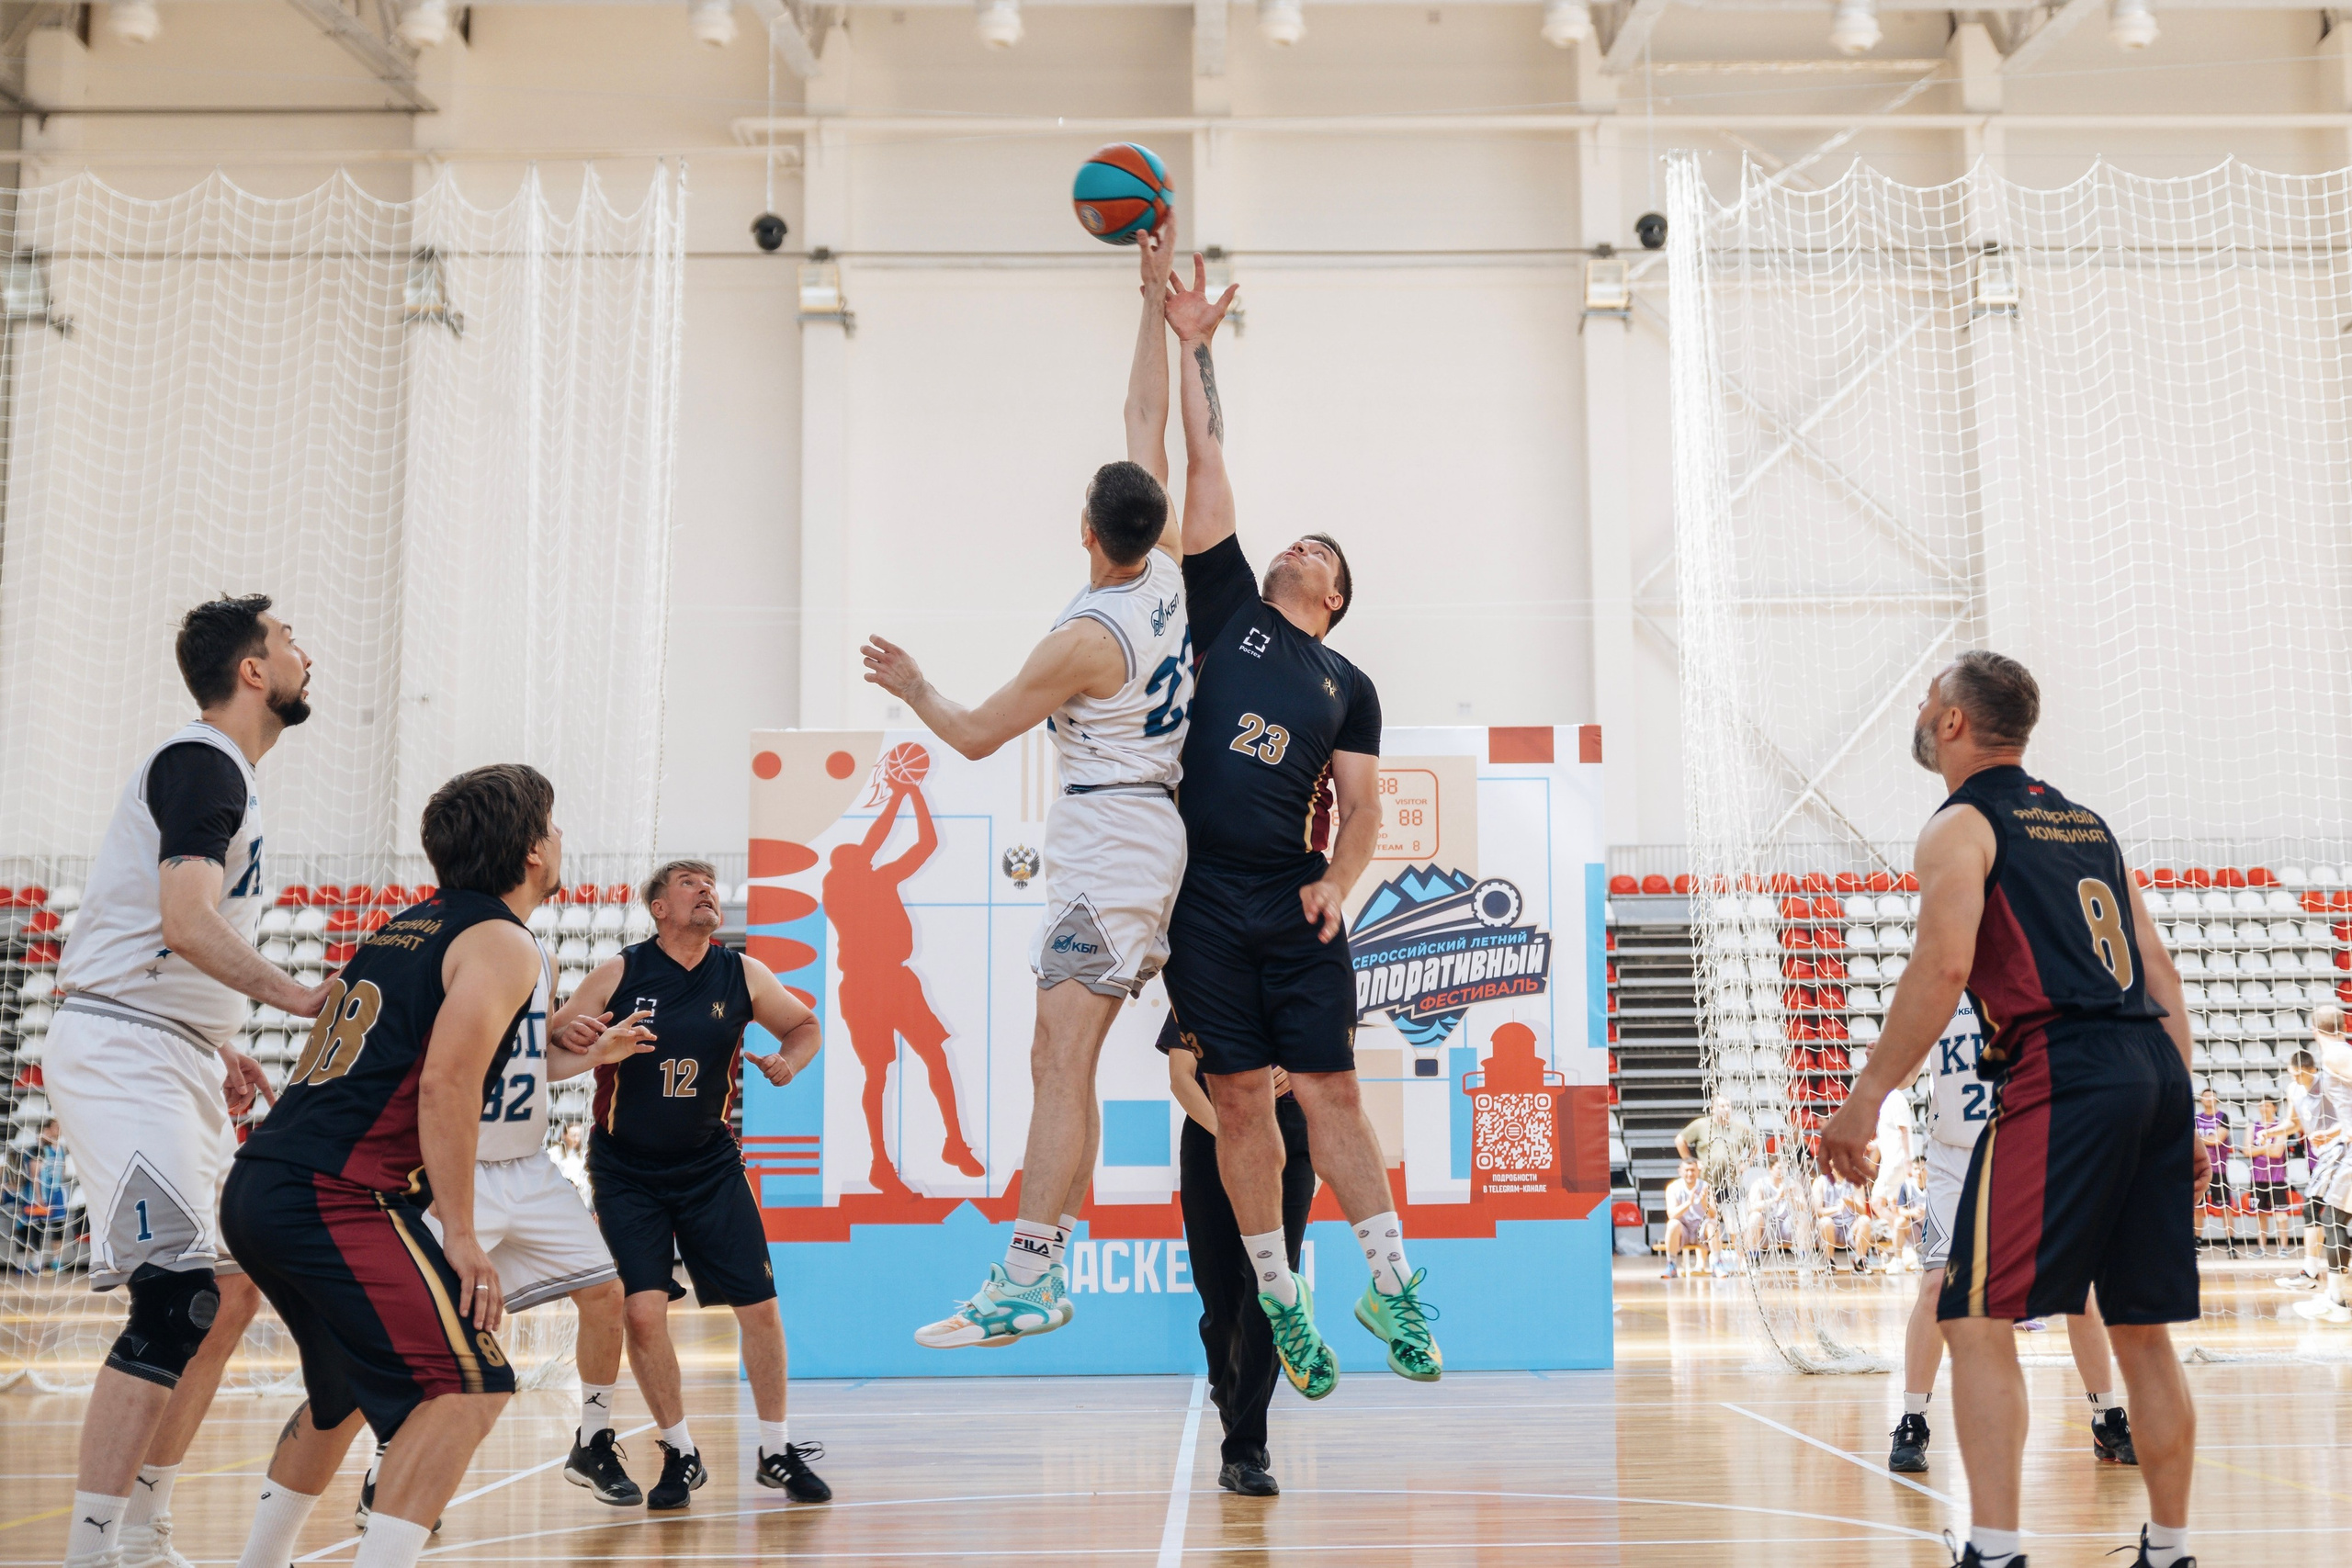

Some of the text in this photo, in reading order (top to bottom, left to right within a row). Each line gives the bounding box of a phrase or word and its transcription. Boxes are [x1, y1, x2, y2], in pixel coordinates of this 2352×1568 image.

[1164, 592, 1180, 621] КБП
[1230, 712, 1291, 765] 23
[1398, 809, 1423, 826] 88
[2012, 807, 2099, 825] ЯНТАРНЫЙ
[1412, 840, 1420, 852] 8
[2025, 825, 2109, 843] КОМБИНАТ
[2077, 877, 2134, 992] 8
[1071, 942, 1098, 955] КБП
[1352, 931, 1527, 970] СЕРОССИЙСКИЙ ЛЕТНИЙ
[1419, 977, 1539, 1010] ФЕСТИВАЛЬ
[660, 1058, 698, 1098] 12
[1962, 1083, 1996, 1122] 2
[1483, 1185, 1487, 1193] В
[1492, 1173, 1538, 1182] ПОДРОБНОСТИ
[134, 1198, 154, 1243] 1
[1012, 1236, 1049, 1255] FILA
